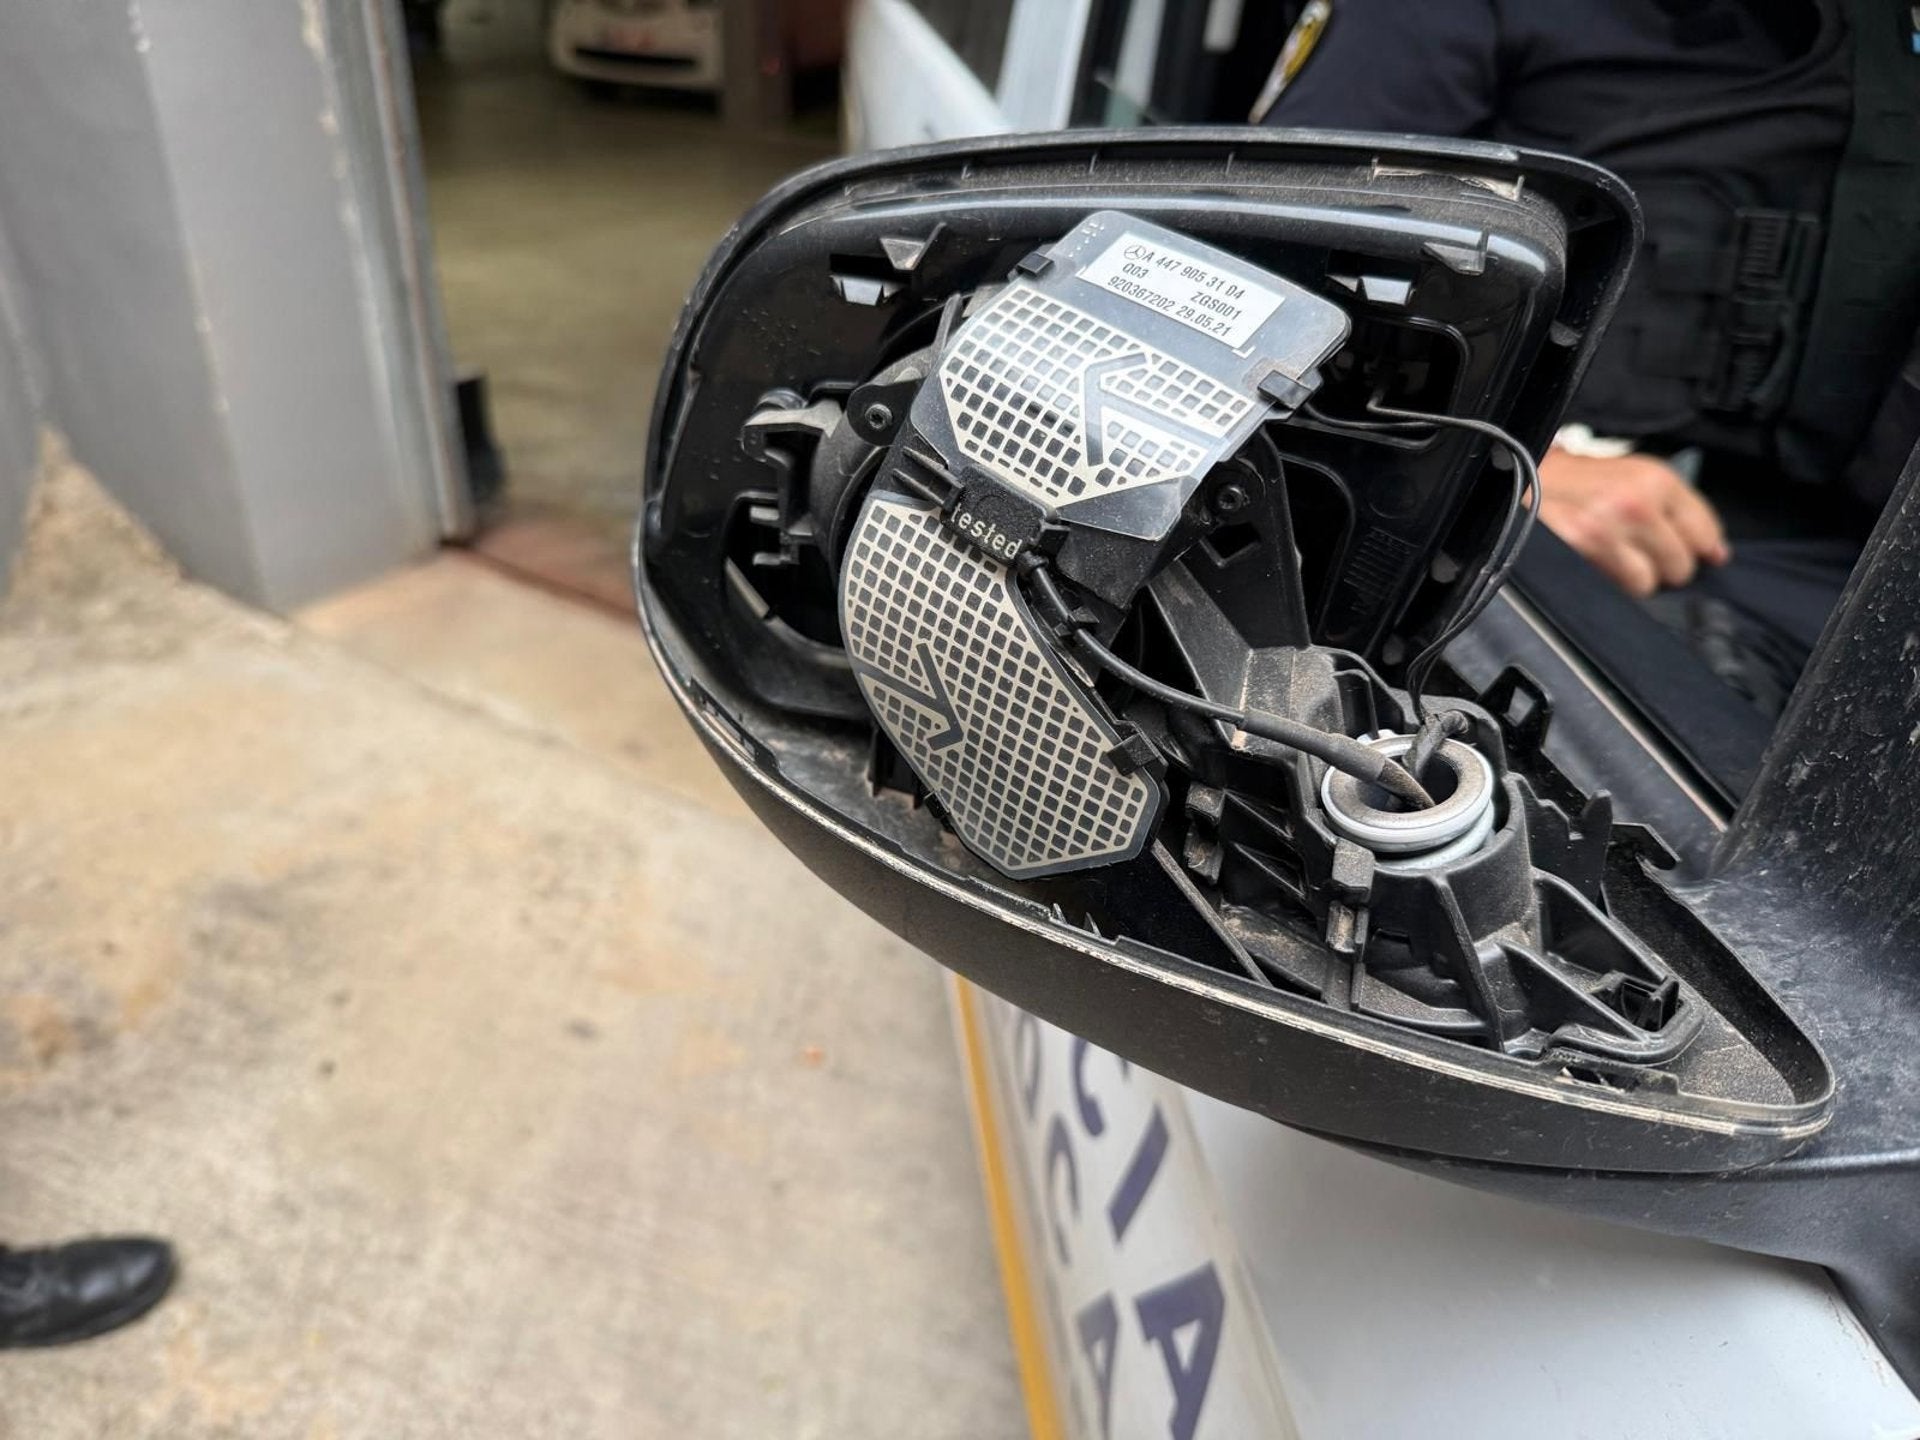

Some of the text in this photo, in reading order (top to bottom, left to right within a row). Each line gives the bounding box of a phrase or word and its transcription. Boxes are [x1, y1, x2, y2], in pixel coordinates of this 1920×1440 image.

[1141, 251, 1246, 300] A 447 905 31 04
[1107, 275, 1232, 337] 920367202 29.05.21
[1190, 291, 1243, 321] ZGS001
[950, 502, 1023, 559] tested
